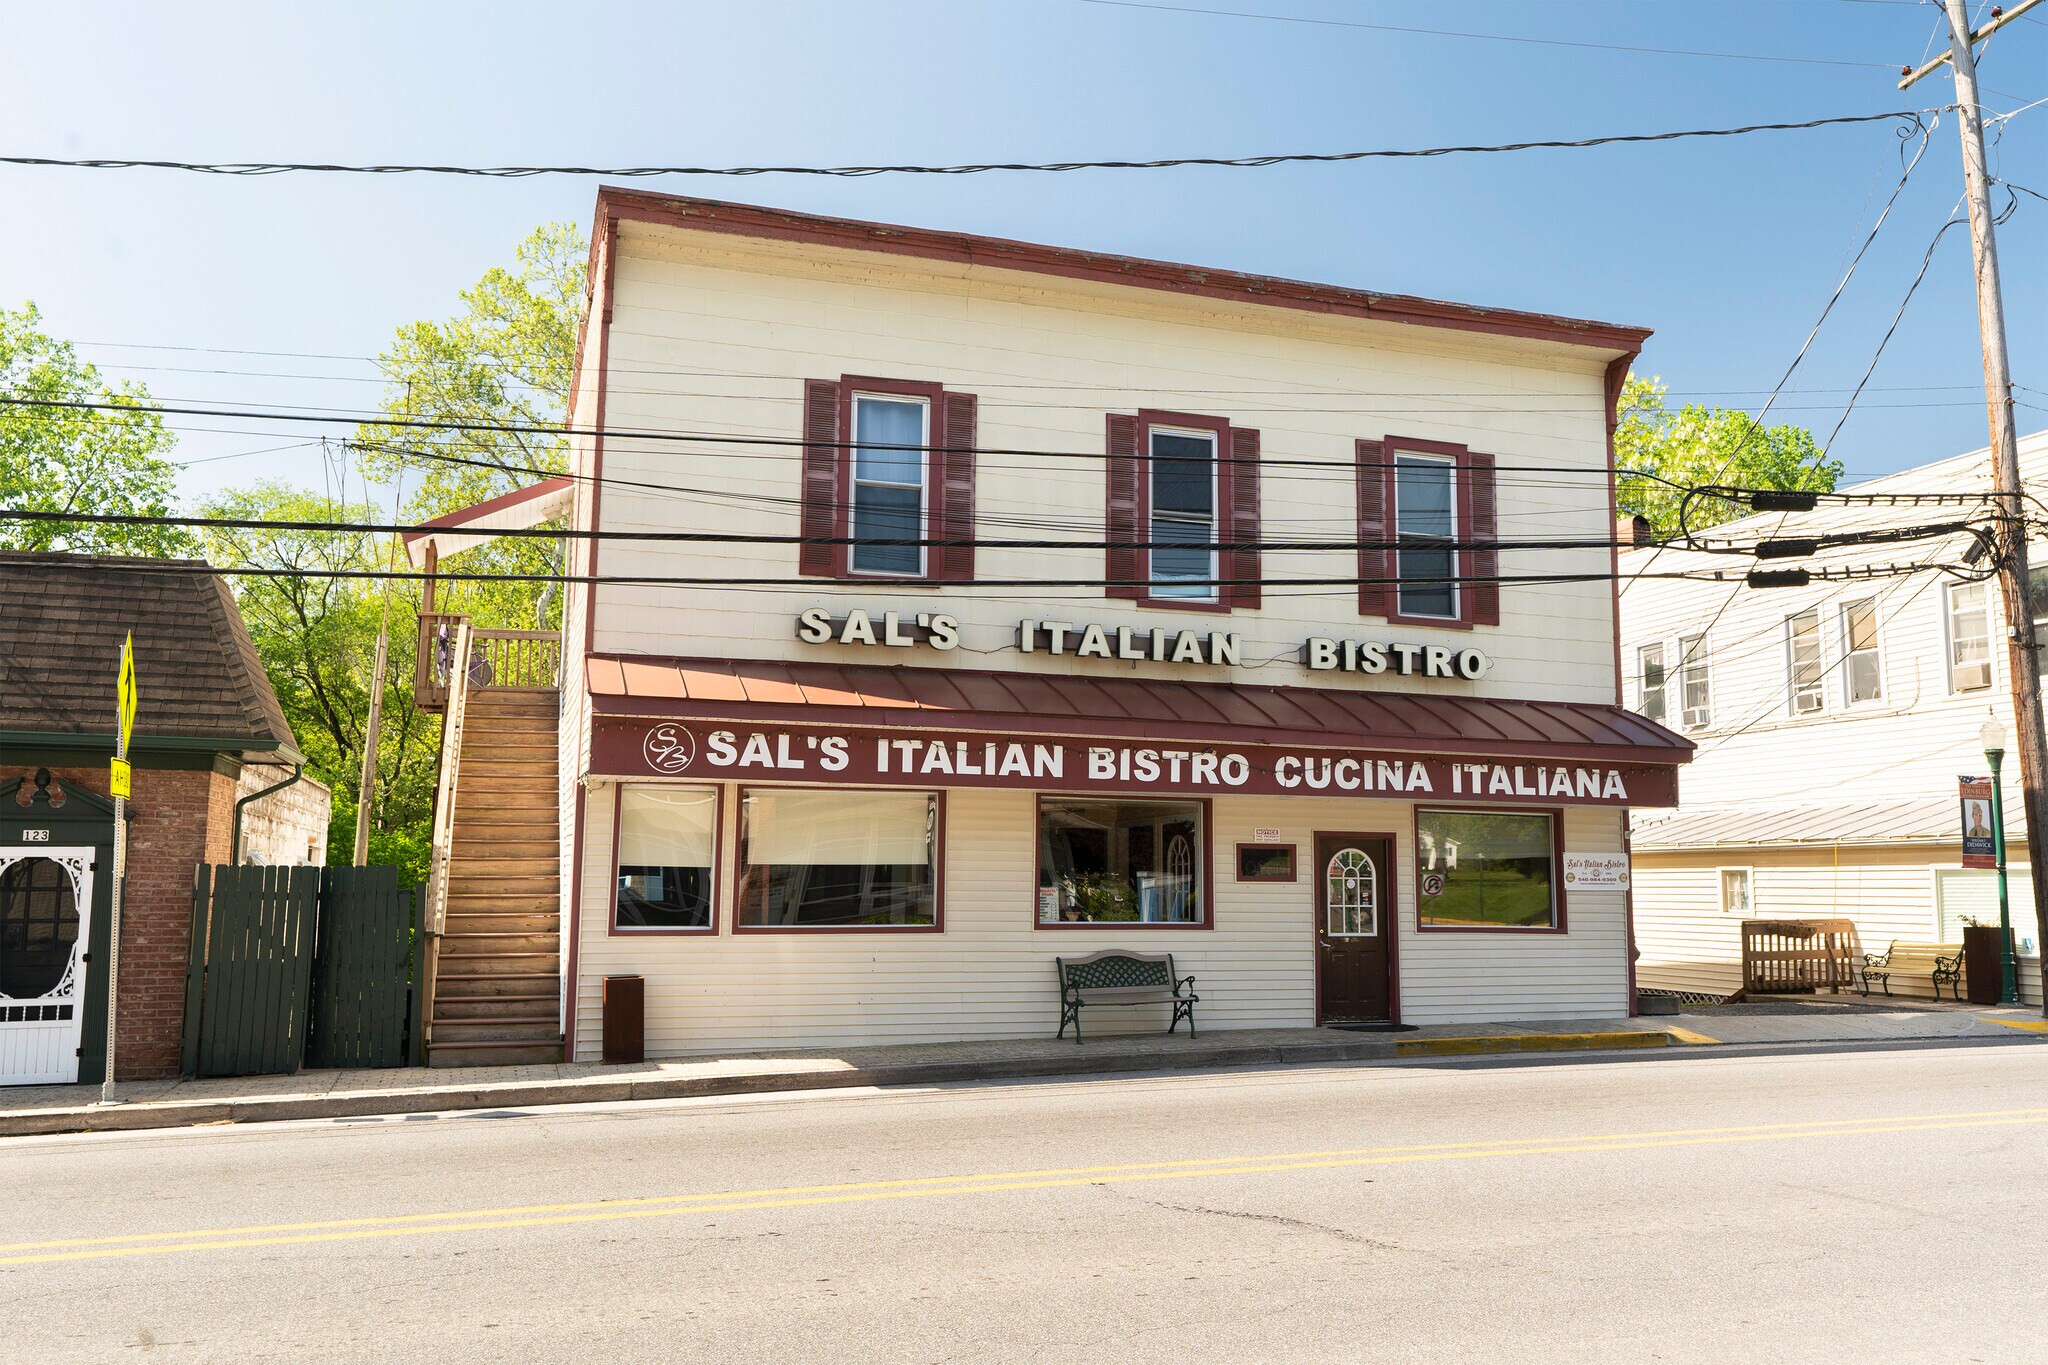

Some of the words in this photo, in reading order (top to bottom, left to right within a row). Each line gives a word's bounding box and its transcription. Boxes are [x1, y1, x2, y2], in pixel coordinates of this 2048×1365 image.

[799, 607, 959, 650] SAL'S
[1018, 618, 1241, 666] ITALIAN
[1305, 636, 1489, 681] BISTRO
[705, 730, 850, 771] SAL'S
[877, 738, 1064, 778] ITALIAN
[1088, 746, 1250, 786] BISTRO
[1274, 756, 1433, 792] CUCINA
[1452, 763, 1628, 799] ITALIANA
[1961, 787, 1991, 795] EDINBURG
[25, 831, 48, 841] 123
[1567, 859, 1583, 870] Sal's
[1584, 859, 1603, 870] Italian
[1604, 859, 1626, 870] Bistro
